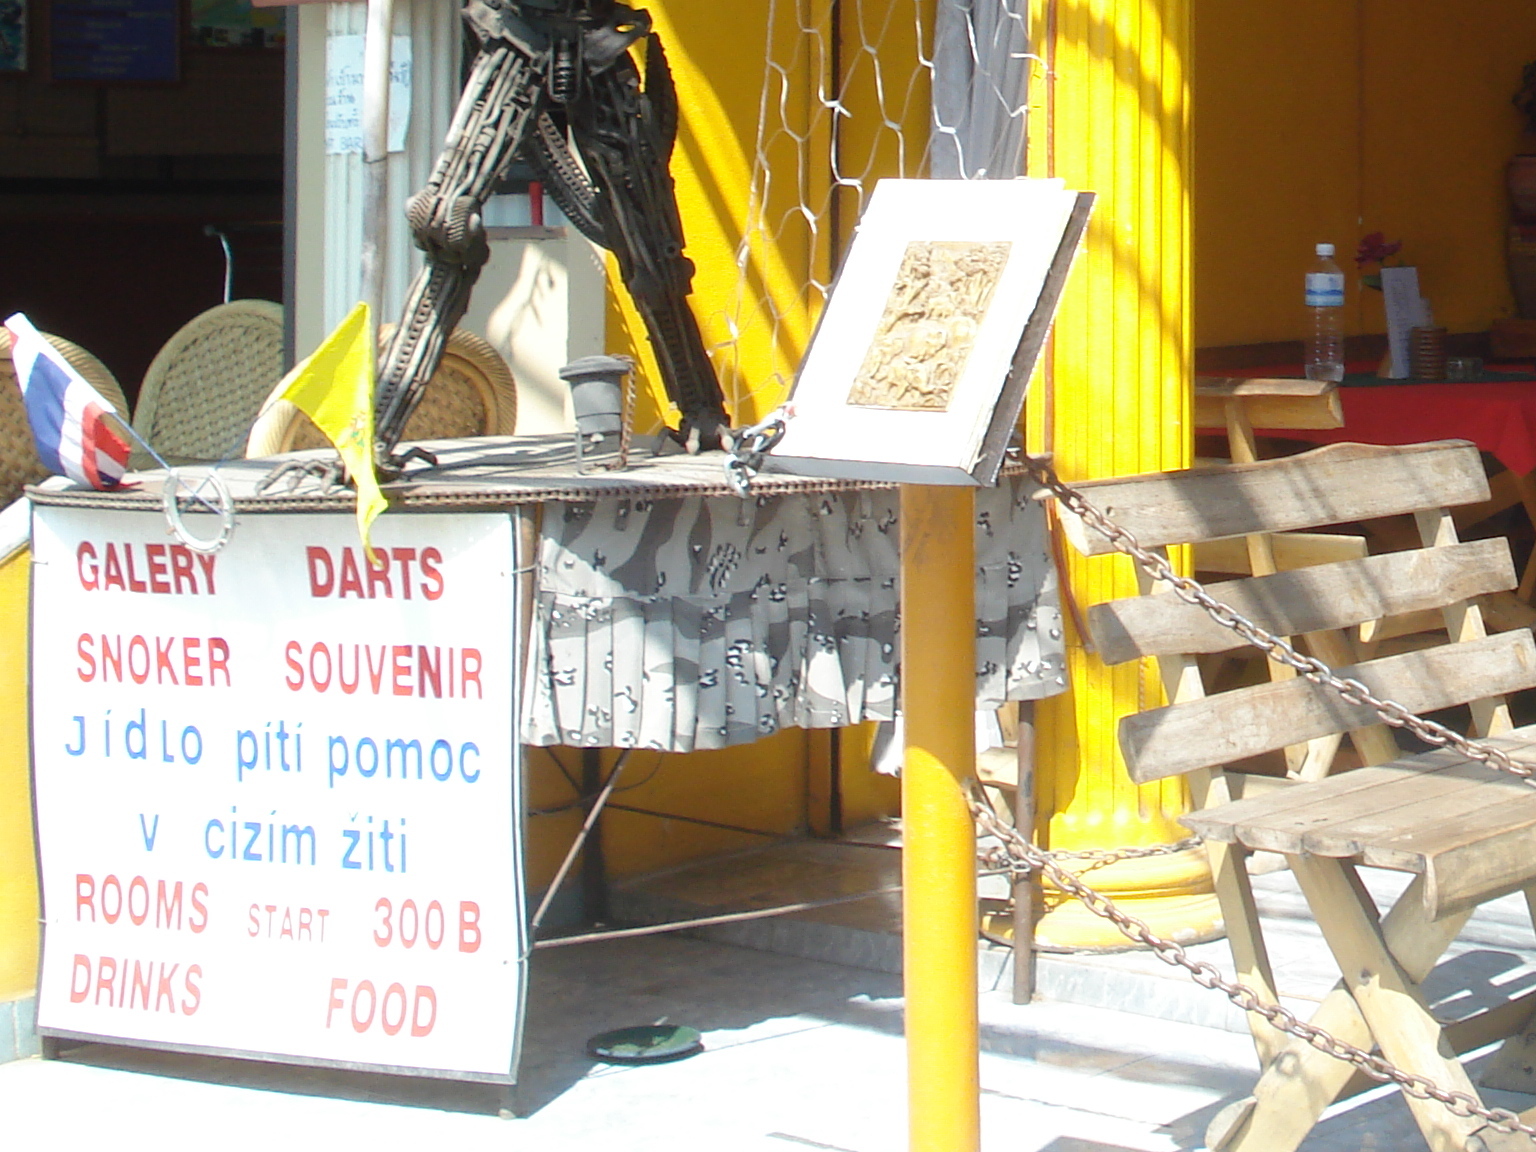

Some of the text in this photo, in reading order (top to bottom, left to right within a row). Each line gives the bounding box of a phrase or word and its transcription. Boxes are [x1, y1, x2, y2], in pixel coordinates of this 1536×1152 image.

[77, 540, 444, 601] GALERY DARTS
[77, 632, 483, 700] SNOKER SOUVENIR
[237, 720, 303, 782] pití
[328, 735, 480, 789] pomoc
[204, 805, 316, 866] cizím
[342, 811, 407, 873] žiti
[76, 873, 209, 933] ROOMS
[248, 903, 330, 943] START
[70, 953, 437, 1037] DRINKS FOOD
